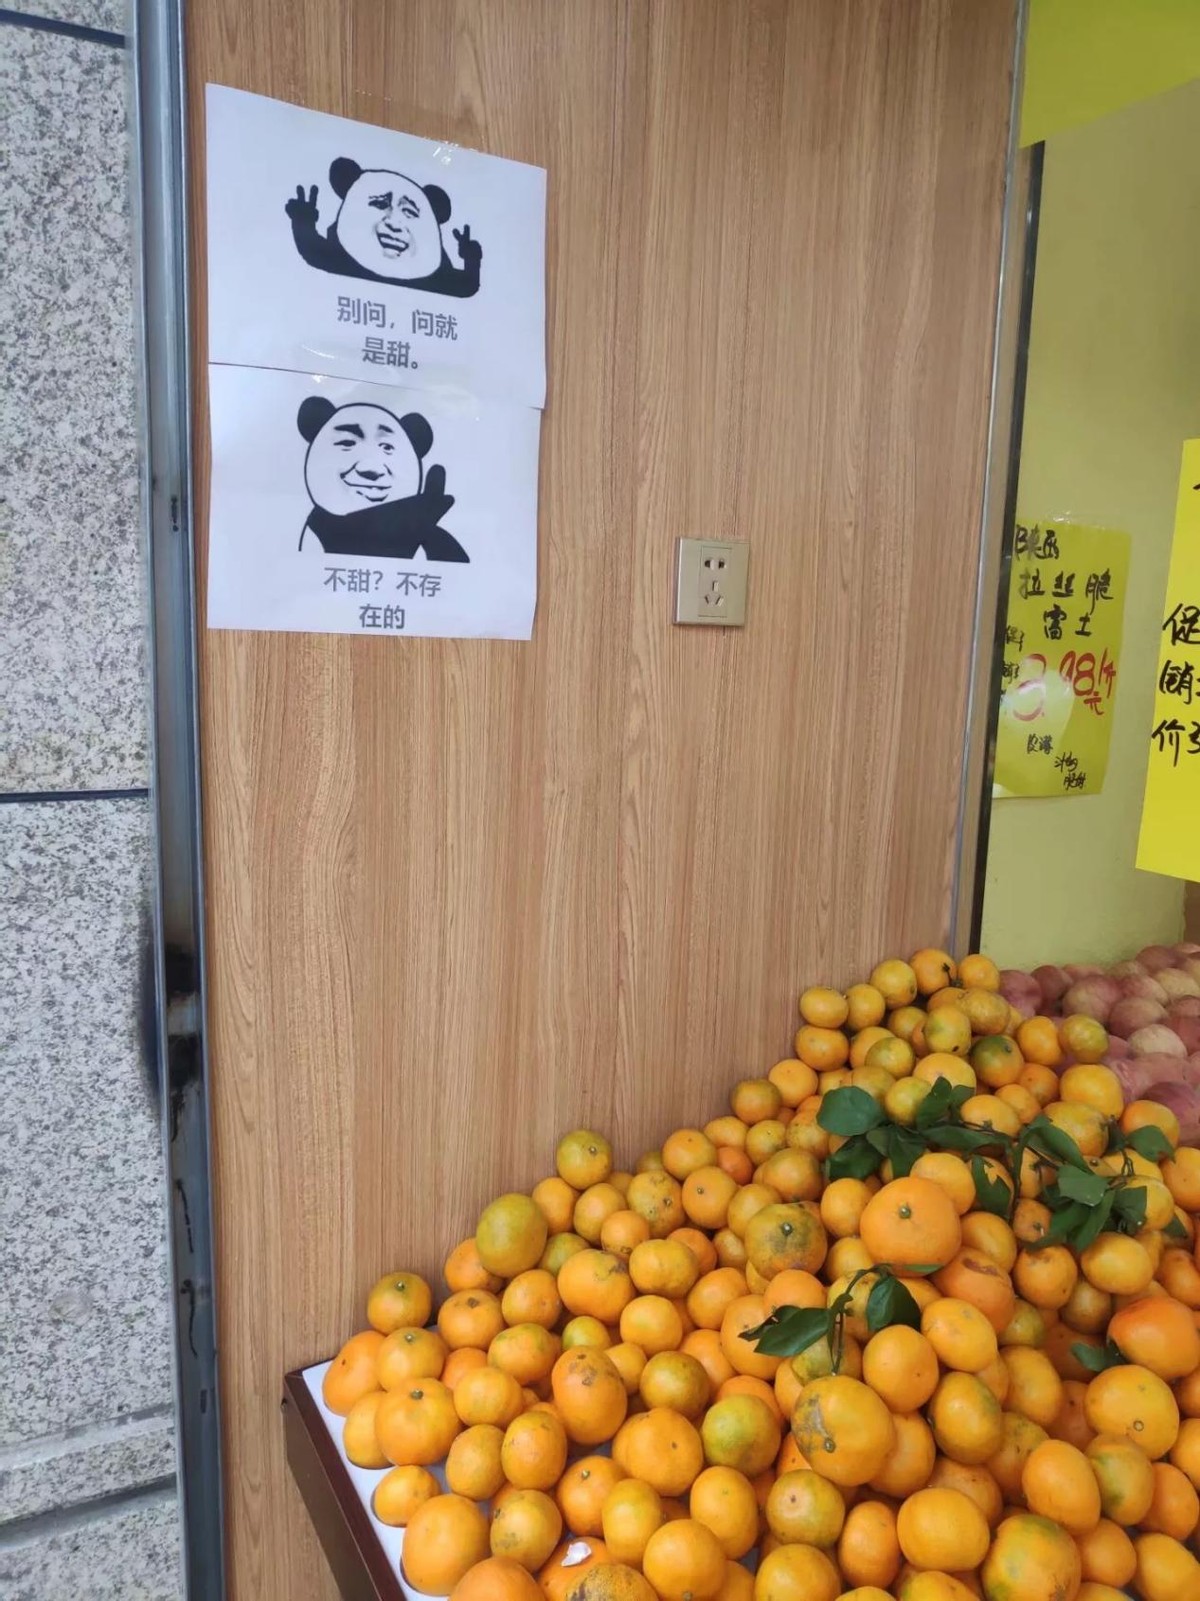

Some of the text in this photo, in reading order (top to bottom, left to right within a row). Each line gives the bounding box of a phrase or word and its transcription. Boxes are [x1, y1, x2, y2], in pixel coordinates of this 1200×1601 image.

[337, 296, 458, 341] 别问，问就
[362, 336, 418, 370] 是甜。
[323, 567, 442, 597] 不甜？不存
[359, 603, 405, 629] 在的
[1043, 603, 1092, 640] 富士
